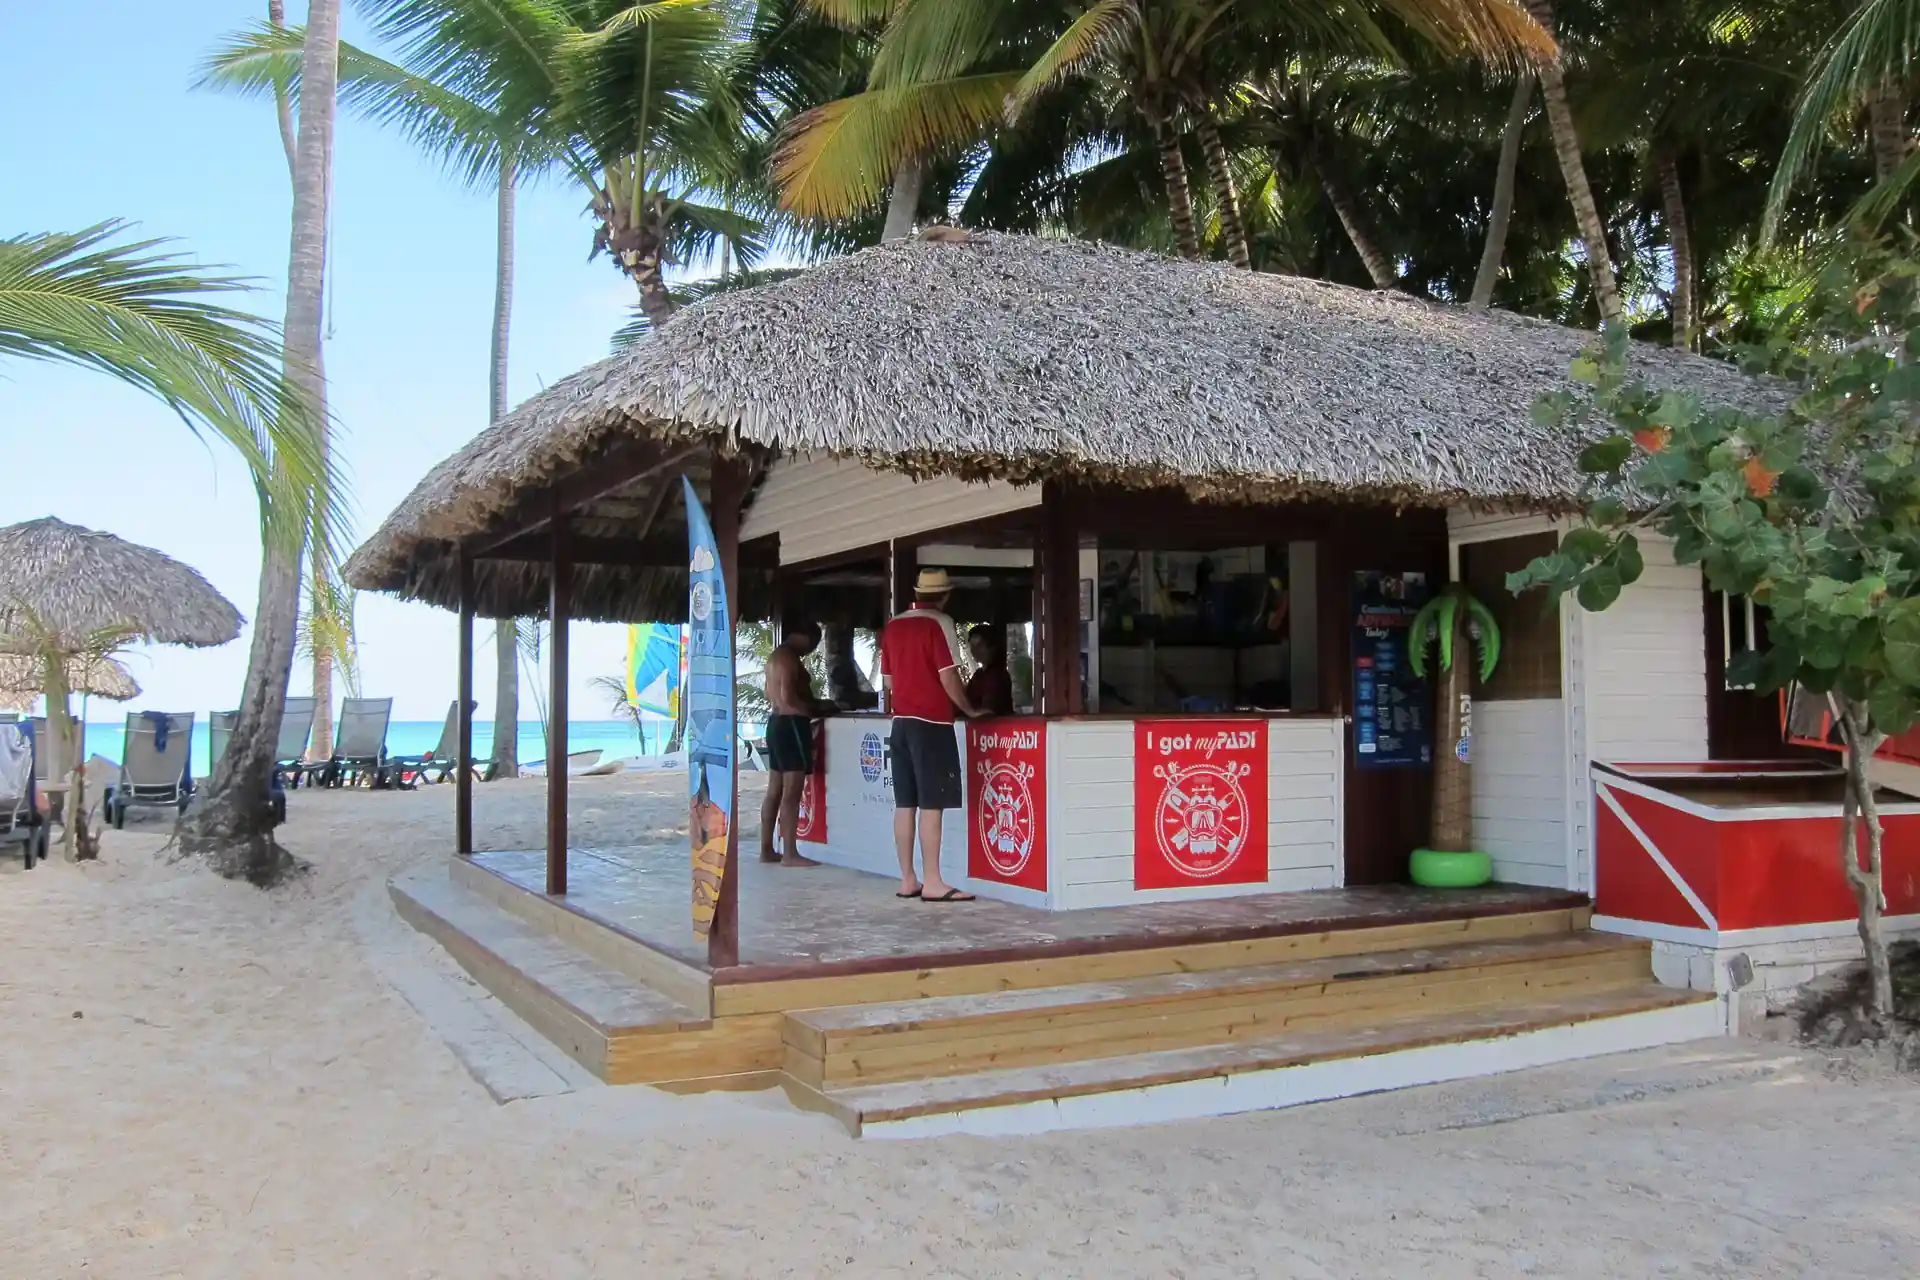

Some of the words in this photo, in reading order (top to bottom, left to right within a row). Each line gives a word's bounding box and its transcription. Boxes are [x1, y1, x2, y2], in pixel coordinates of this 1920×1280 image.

[973, 729, 977, 747] I
[980, 733, 998, 753] got
[1147, 731, 1153, 750] I
[1160, 733, 1193, 756] got
